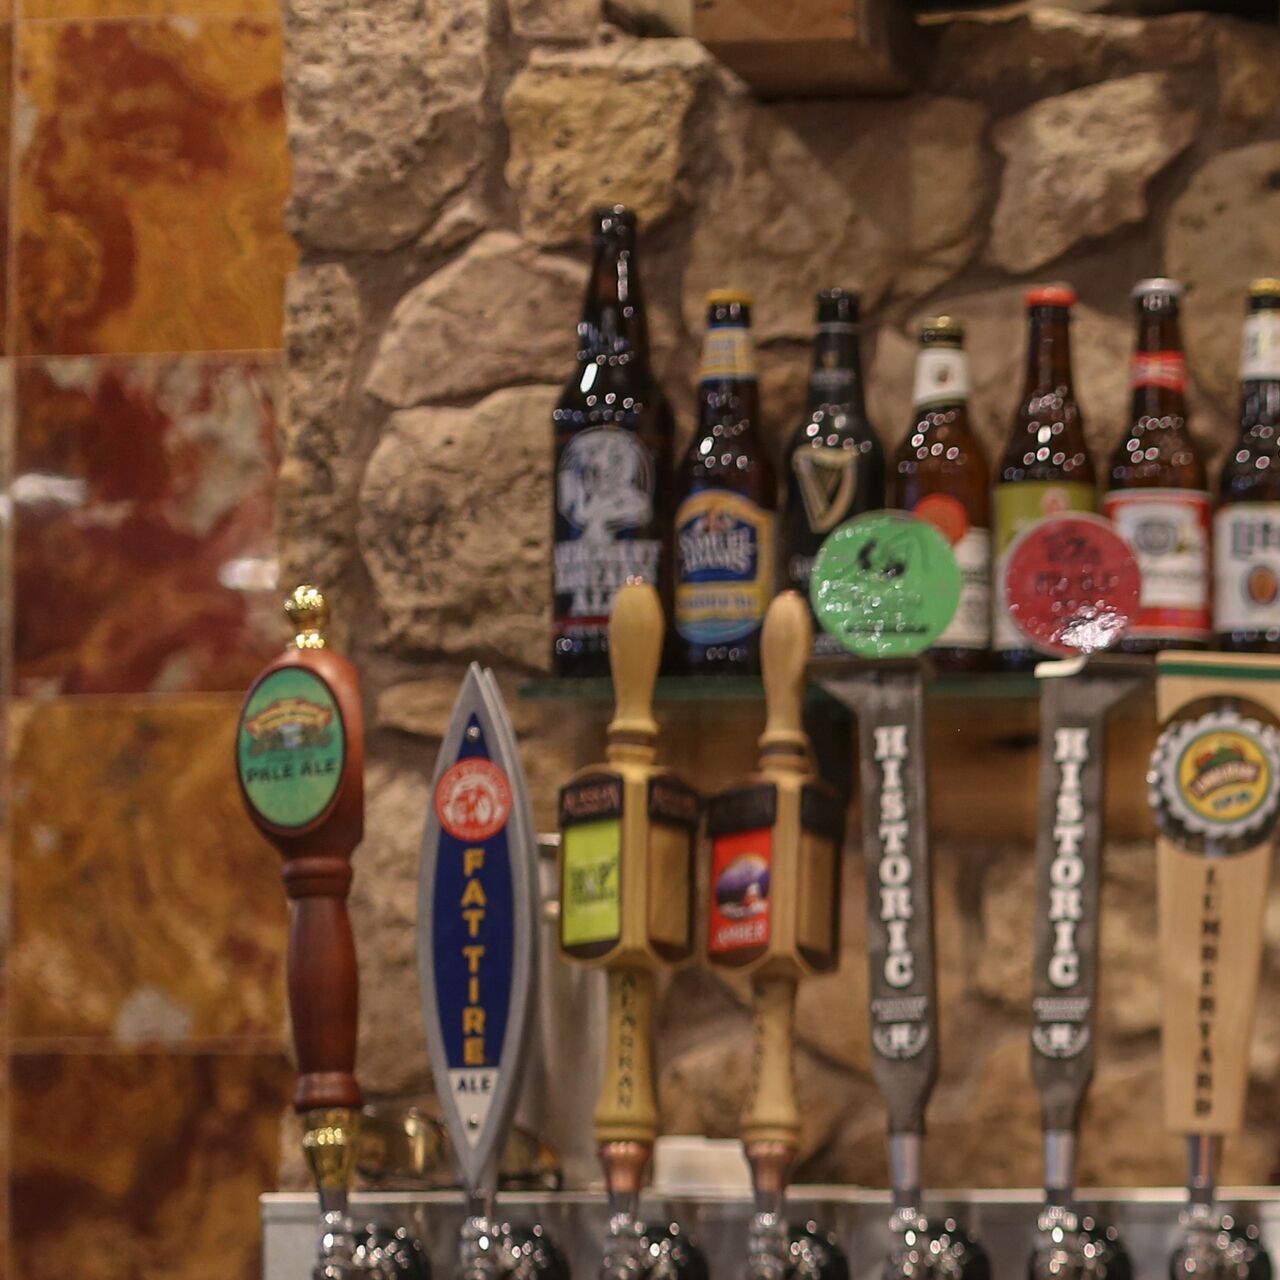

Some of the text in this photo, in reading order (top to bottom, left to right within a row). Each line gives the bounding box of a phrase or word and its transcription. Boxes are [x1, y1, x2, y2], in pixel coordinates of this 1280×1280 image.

[246, 757, 336, 783] PALE ALE
[873, 725, 913, 987] HISTORIC
[1049, 727, 1090, 988] HISTORIC
[460, 848, 487, 1066] FAT TIRE
[714, 922, 767, 945] AMBER
[457, 1077, 490, 1092] ALE
